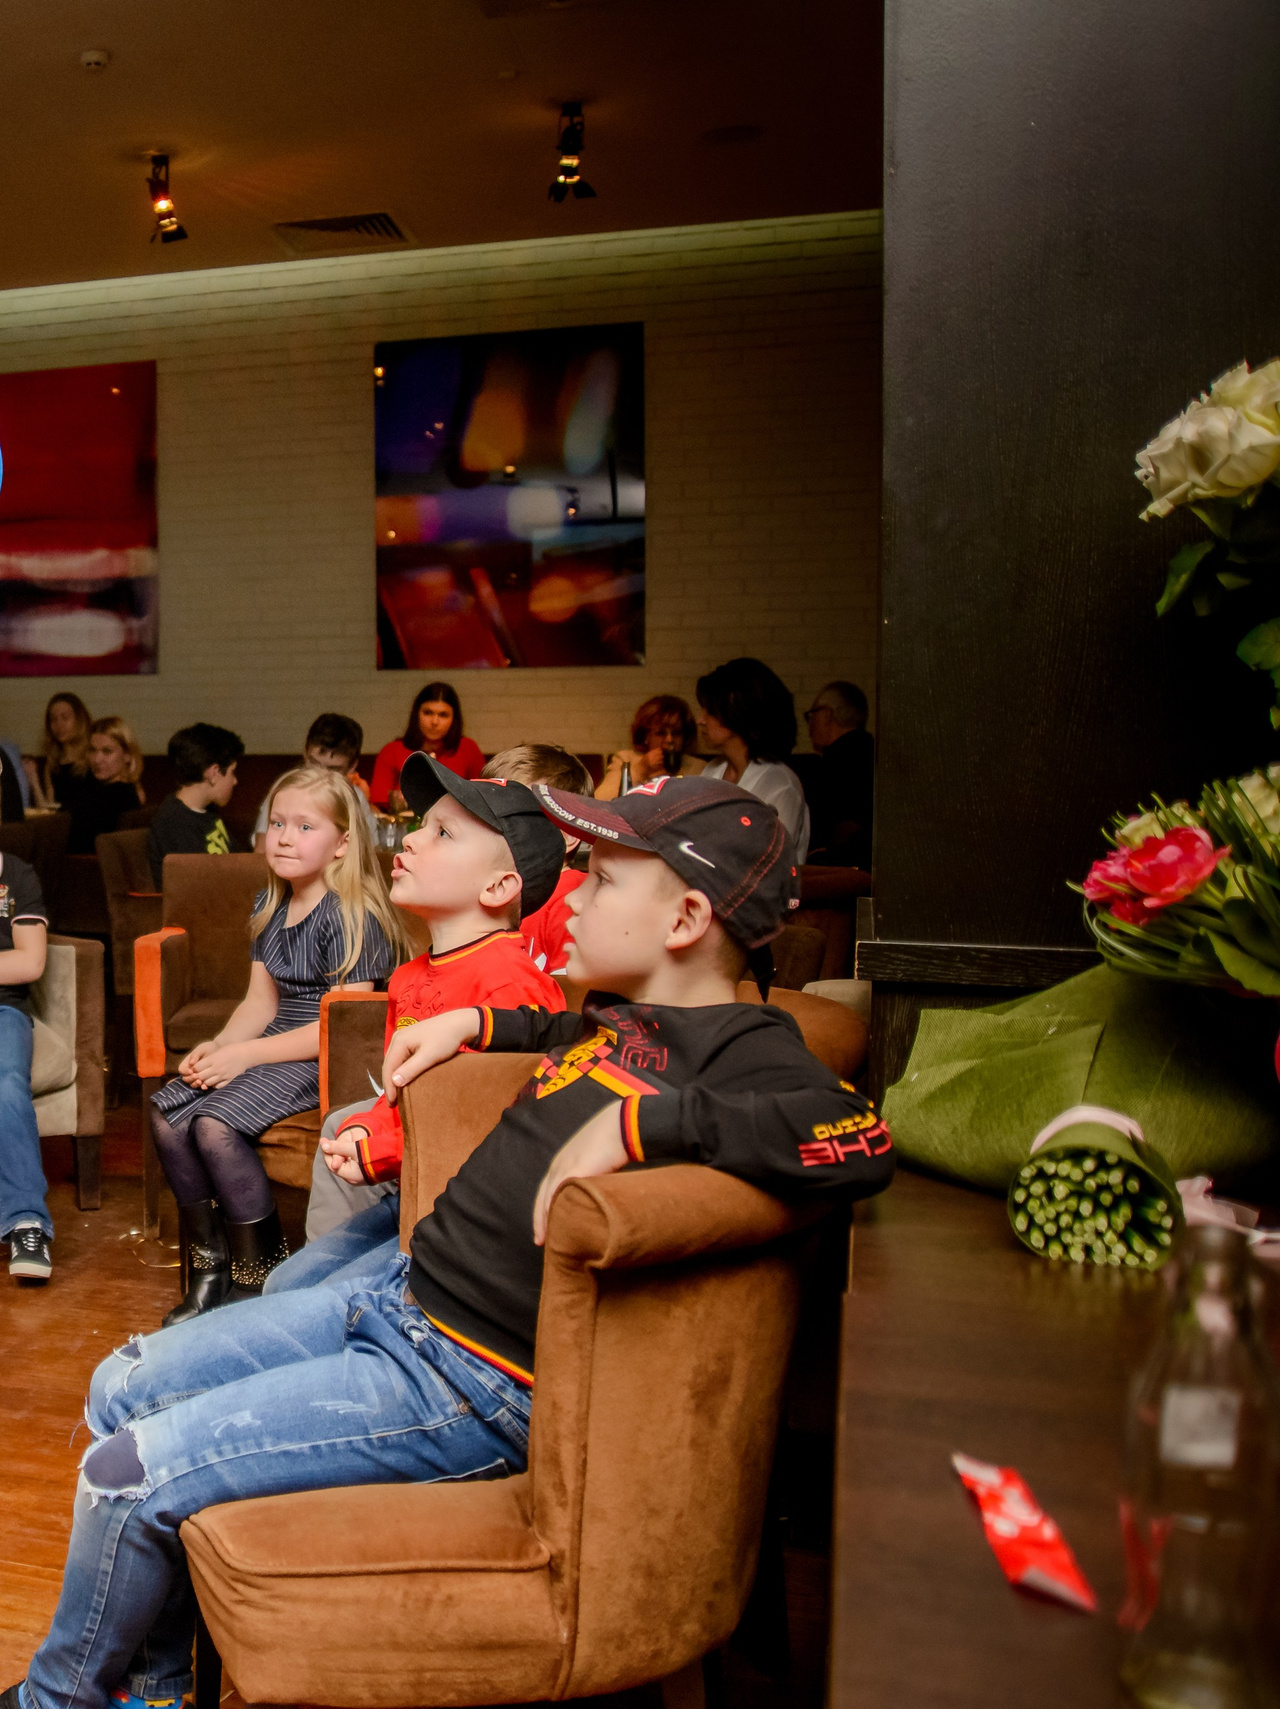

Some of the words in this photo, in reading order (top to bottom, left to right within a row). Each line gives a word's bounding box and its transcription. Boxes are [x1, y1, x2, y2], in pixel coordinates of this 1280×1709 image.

[543, 795, 575, 821] MOSCOW
[576, 818, 619, 839] EST.1935
[799, 1120, 892, 1167] CHE
